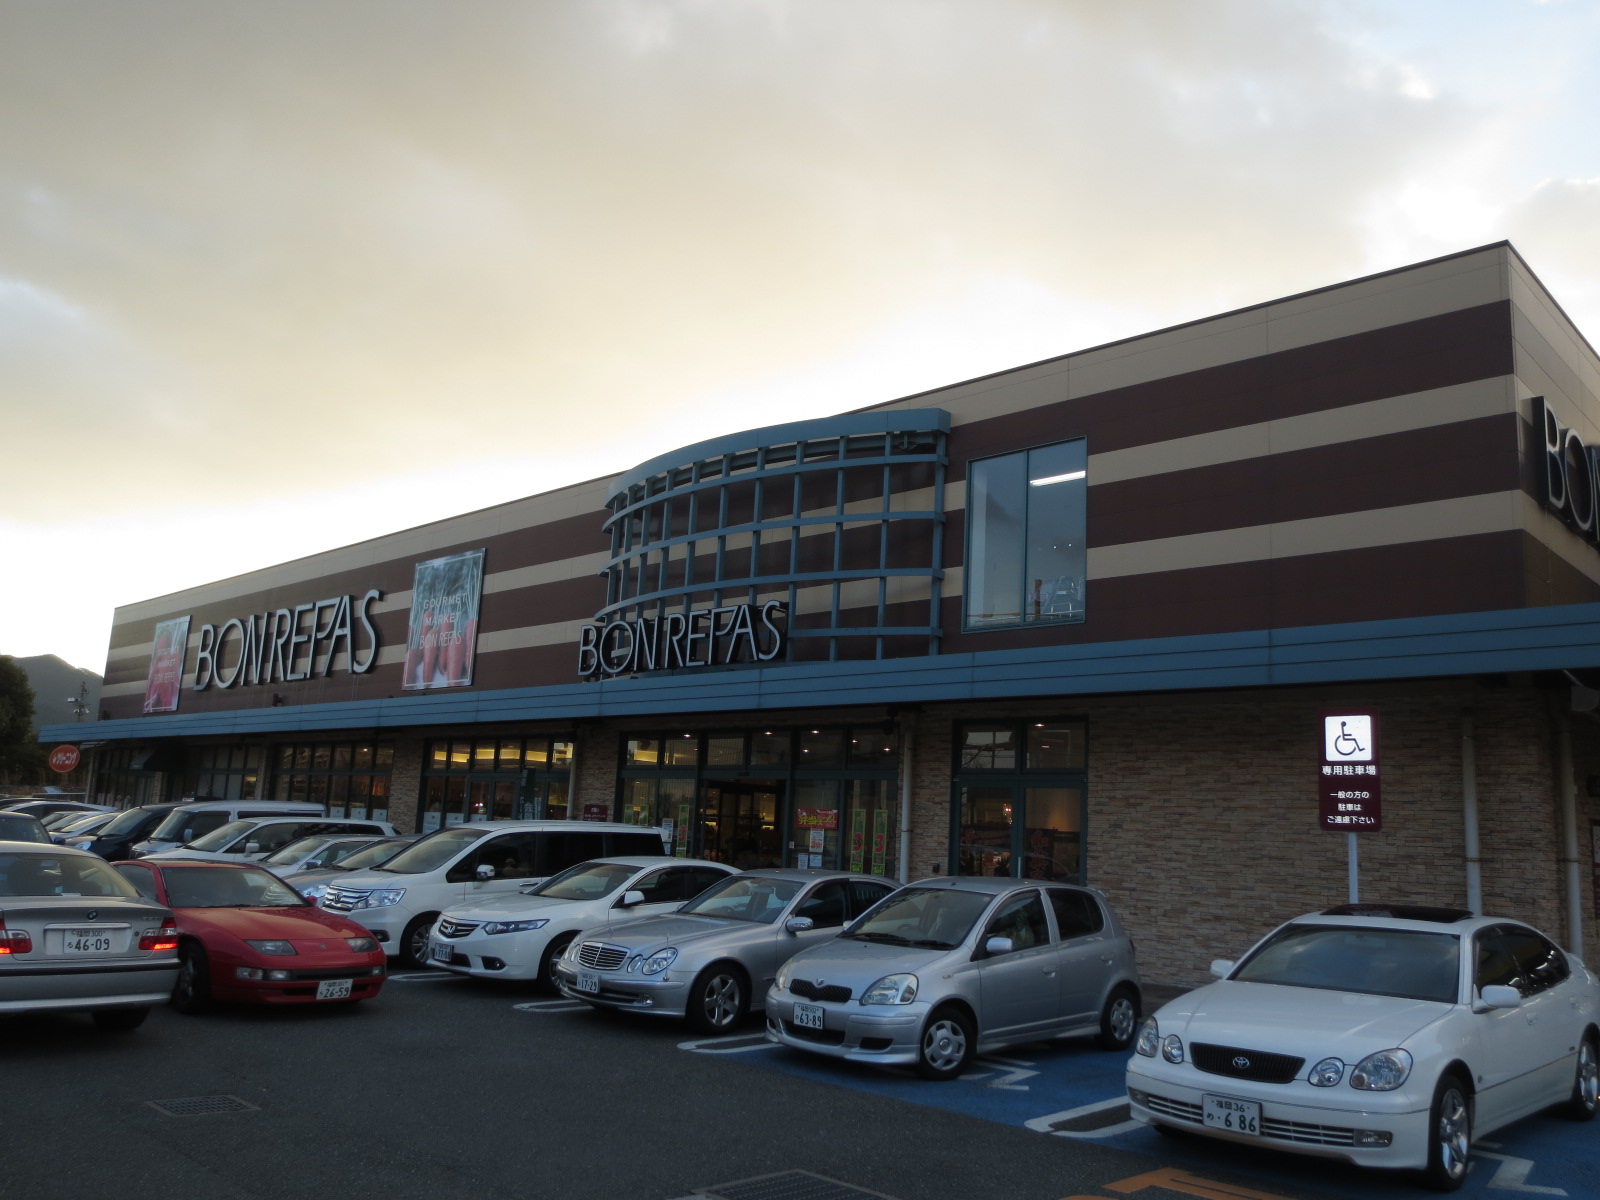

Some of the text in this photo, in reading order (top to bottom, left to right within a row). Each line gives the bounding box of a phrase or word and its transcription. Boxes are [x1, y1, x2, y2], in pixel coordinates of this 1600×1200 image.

[423, 593, 467, 609] GOURMET
[425, 612, 461, 625] MARKET
[1322, 765, 1377, 776] 専用駐車場
[1330, 791, 1370, 799] 一般の方の
[1338, 803, 1361, 811] 駐車は
[1327, 815, 1374, 824] ご遠慮下さい
[74, 938, 110, 952] 46-09
[581, 979, 597, 991] 17-29
[324, 986, 350, 998] 26-59
